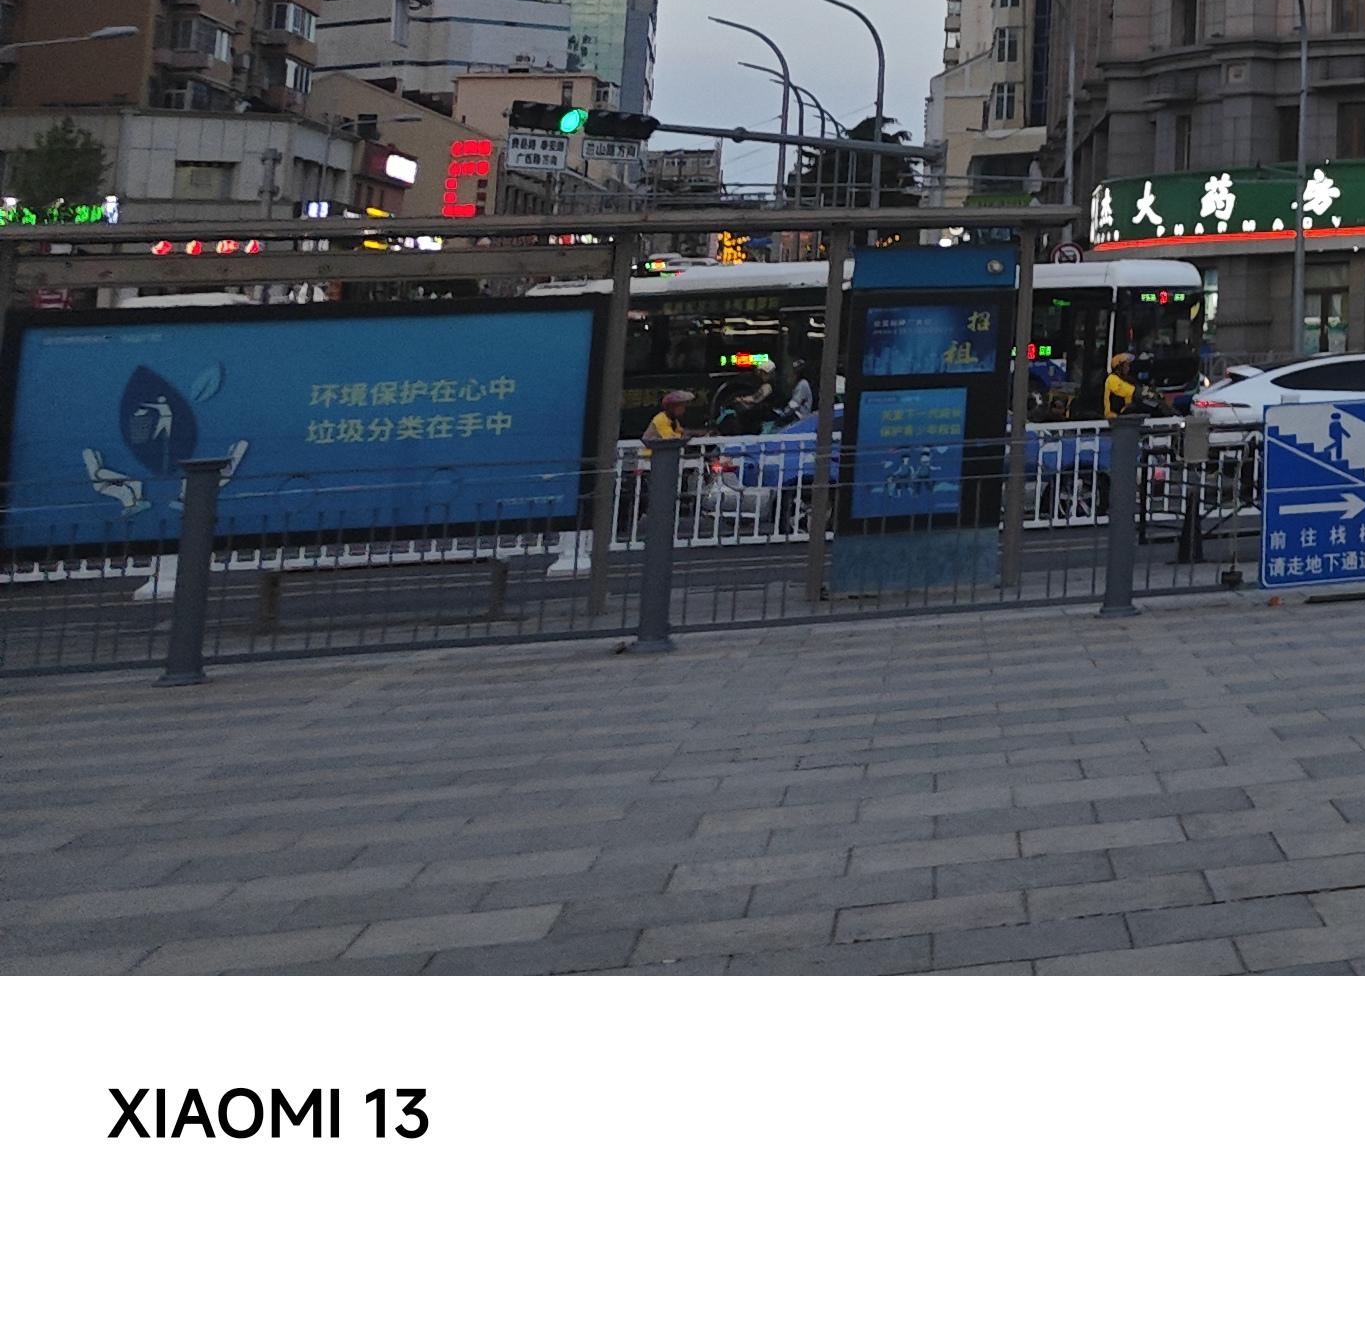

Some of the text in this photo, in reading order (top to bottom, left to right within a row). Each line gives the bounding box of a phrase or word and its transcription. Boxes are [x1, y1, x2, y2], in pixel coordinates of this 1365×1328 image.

[310, 376, 517, 409] 环境保护在心中
[306, 411, 513, 445] 垃圾分类在手中
